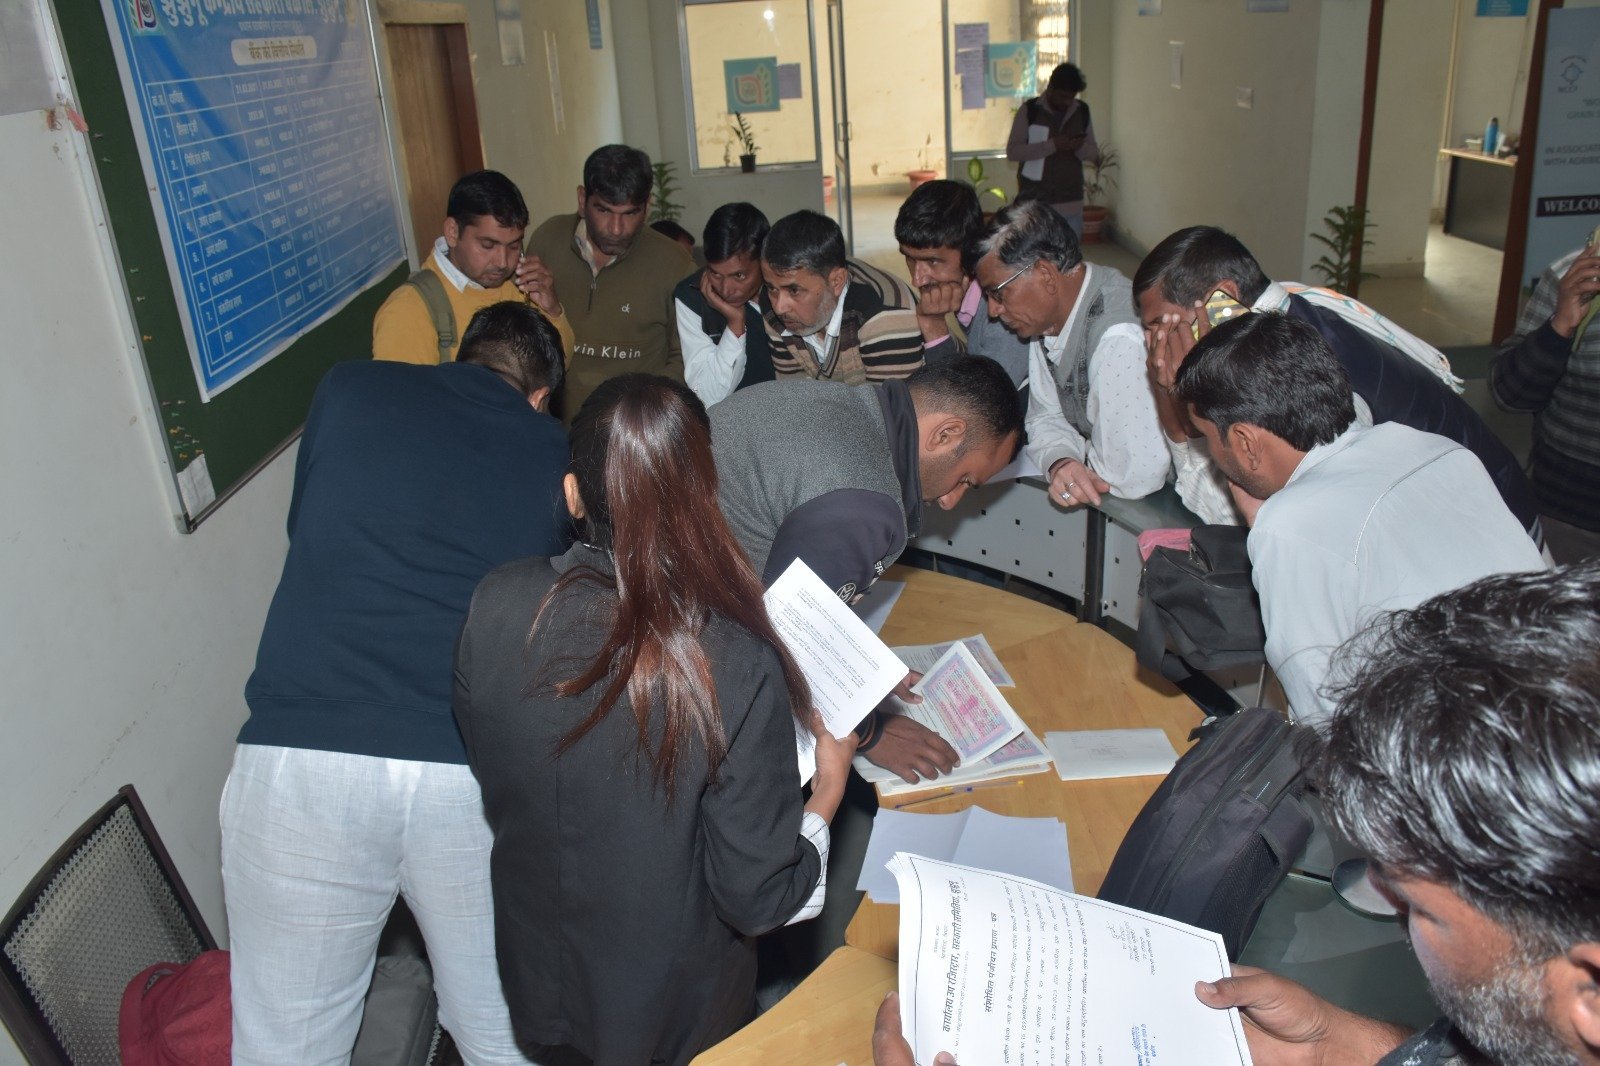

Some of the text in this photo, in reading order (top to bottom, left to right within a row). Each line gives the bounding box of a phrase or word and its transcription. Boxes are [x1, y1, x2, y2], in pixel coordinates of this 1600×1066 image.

[1544, 198, 1600, 213] WELCO
[601, 345, 641, 359] Klein
[990, 912, 998, 922] पत्र
[951, 923, 962, 950] सहकारी
[990, 930, 998, 949] प्रमाण
[947, 953, 960, 985] रजिस्ट्रार,
[987, 951, 997, 978] पंजीयन
[947, 986, 956, 997] उप
[984, 981, 995, 1012] संशोधित
[942, 999, 954, 1033] कार्यालय
